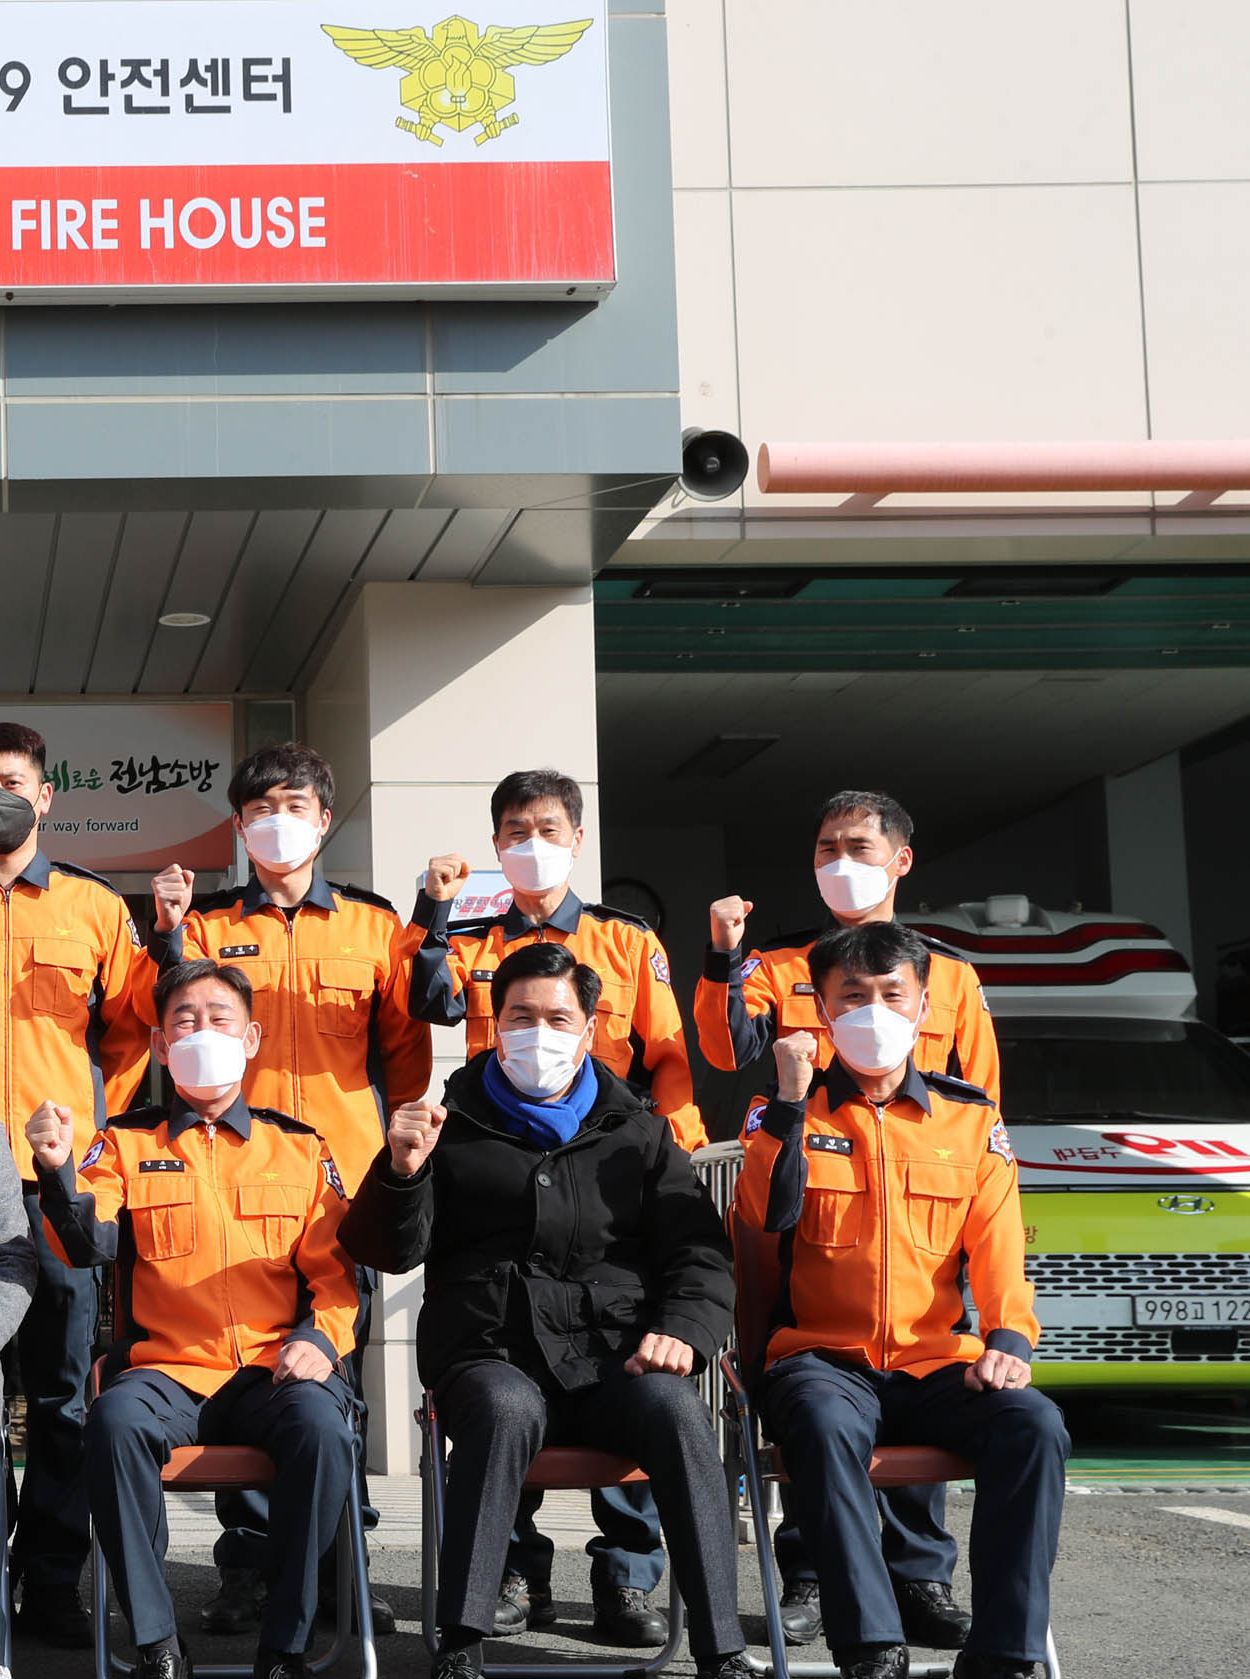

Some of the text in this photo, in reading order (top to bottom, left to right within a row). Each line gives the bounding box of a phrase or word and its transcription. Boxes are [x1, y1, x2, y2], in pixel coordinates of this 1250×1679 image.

[57, 56, 292, 116] 안전센터
[11, 198, 119, 251] FIRE
[139, 196, 327, 250] HOUSE
[109, 755, 220, 794] 전남소방
[53, 823, 80, 835] way
[86, 819, 139, 832] forward
